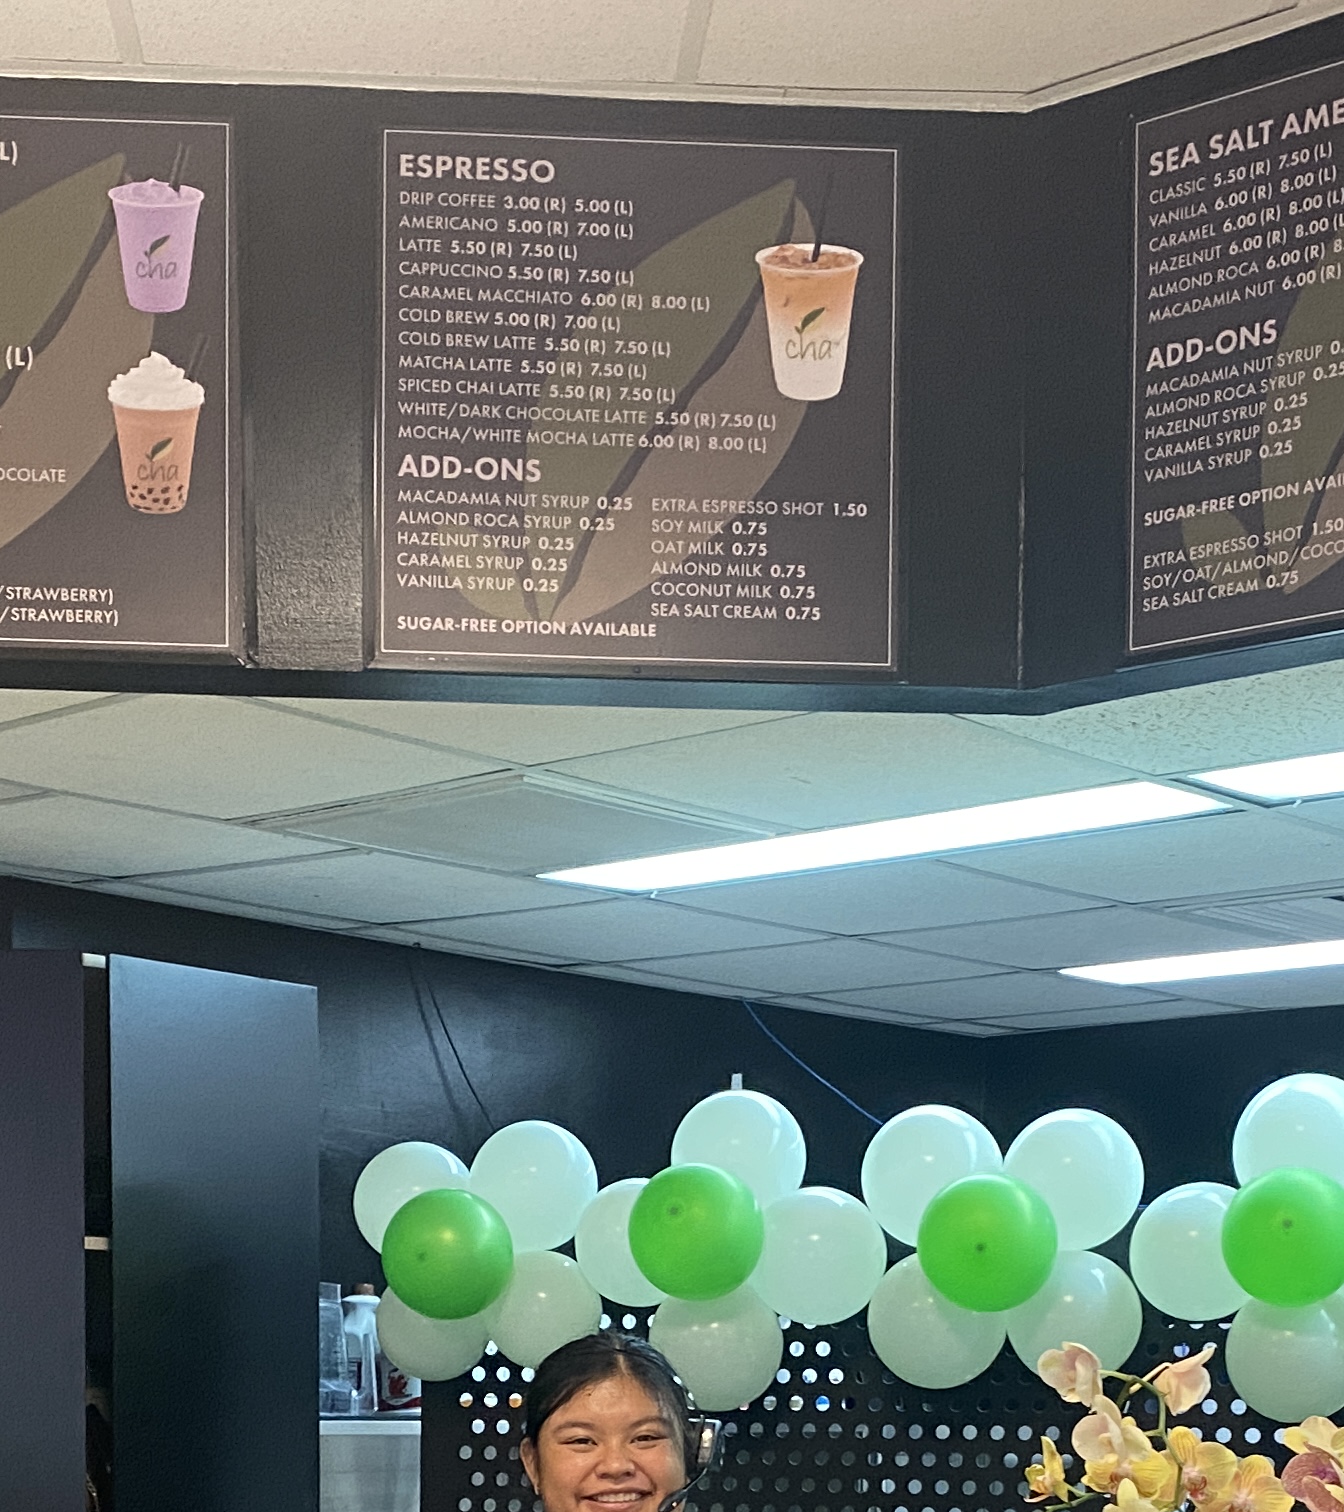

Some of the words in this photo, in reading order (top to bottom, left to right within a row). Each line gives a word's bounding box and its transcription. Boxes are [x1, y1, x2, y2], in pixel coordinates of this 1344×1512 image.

[1148, 141, 1201, 177] SEA
[1208, 118, 1274, 160] SALT
[399, 153, 555, 184] ESPRESSO
[1148, 176, 1206, 205] CLASSIC
[1213, 165, 1247, 188] 5.50
[1249, 158, 1271, 180] (R)
[1278, 148, 1310, 170] 7.50
[1313, 140, 1333, 163] (L)
[398, 214, 499, 232] AMERICANO
[506, 218, 543, 234] 5.00
[546, 219, 569, 238] (R)
[577, 221, 611, 237] 7.00
[614, 222, 634, 240] (L)
[135, 250, 178, 280] cha
[5, 345, 33, 371] (L)
[784, 327, 832, 361] cha
[1145, 318, 1277, 372] ADD-ONS
[1144, 410, 1219, 440] HAZELNUT
[1221, 401, 1267, 424] SYRUP
[1273, 391, 1308, 412] 0.25
[136, 454, 179, 482] cha
[397, 453, 541, 483] ADD-ONS
[651, 497, 697, 512] EXTRA
[702, 498, 778, 515] ESPRESSO
[782, 501, 824, 516] SHOT
[833, 502, 868, 517] 1.50
[1143, 494, 1235, 527] SUGAR-FREE
[1238, 481, 1299, 507] OPTION
[650, 581, 732, 598] COCONUT
[735, 583, 772, 599] MILK
[779, 584, 816, 600] 0.75
[396, 615, 497, 633] SUGAR-FREE
[500, 619, 566, 635] OPTION
[569, 621, 657, 638] AVAILABLE
[650, 602, 680, 617] SEA
[683, 603, 719, 618] SALT
[722, 604, 777, 619] CREAM
[784, 605, 821, 621] 0.75
